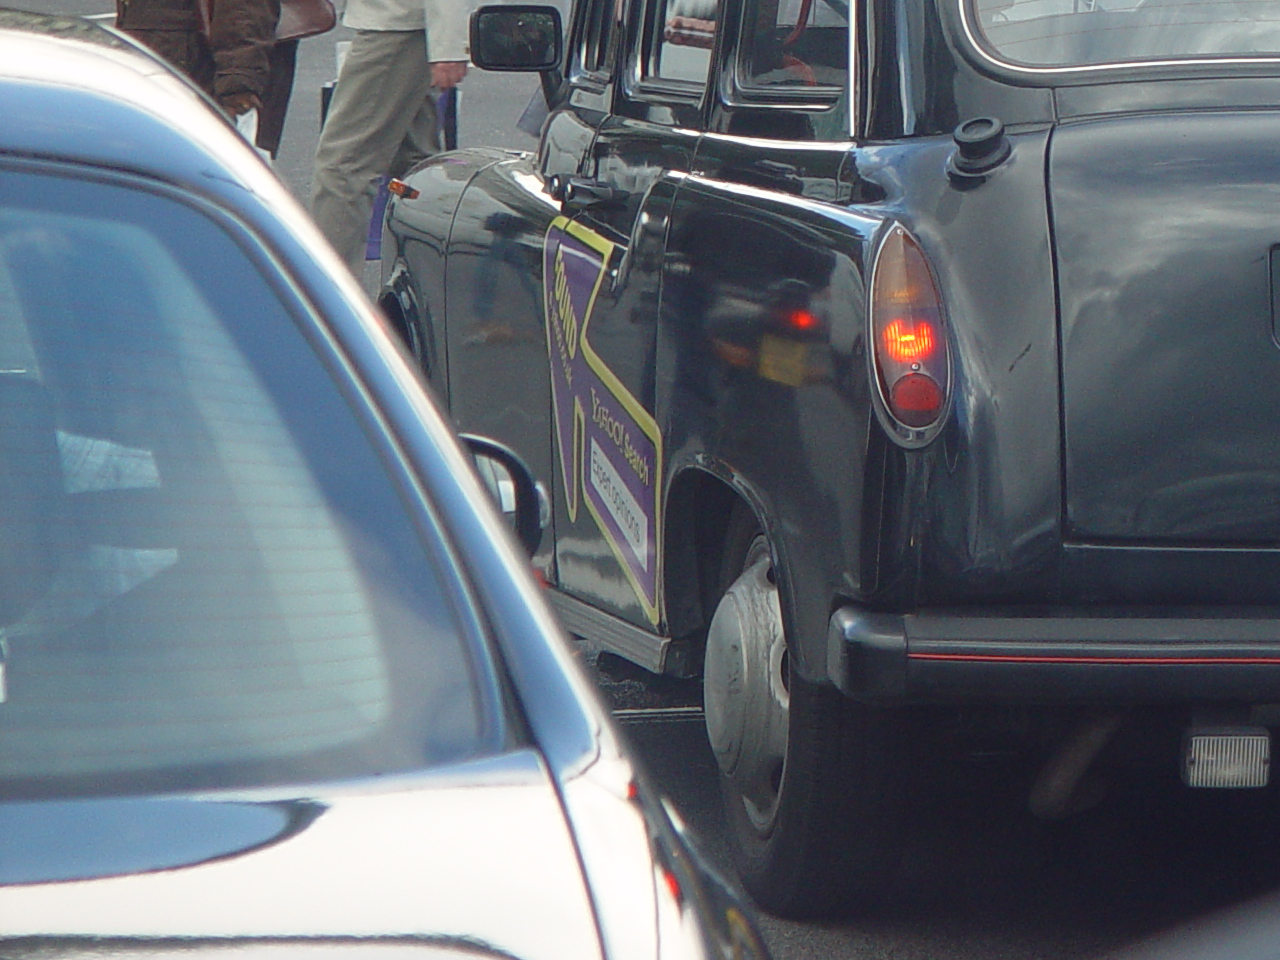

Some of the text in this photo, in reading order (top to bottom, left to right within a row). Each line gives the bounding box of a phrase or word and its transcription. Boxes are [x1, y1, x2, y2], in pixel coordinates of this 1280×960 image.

[592, 450, 611, 498] Expert
[624, 432, 649, 486] Search
[611, 484, 641, 544] opinions
